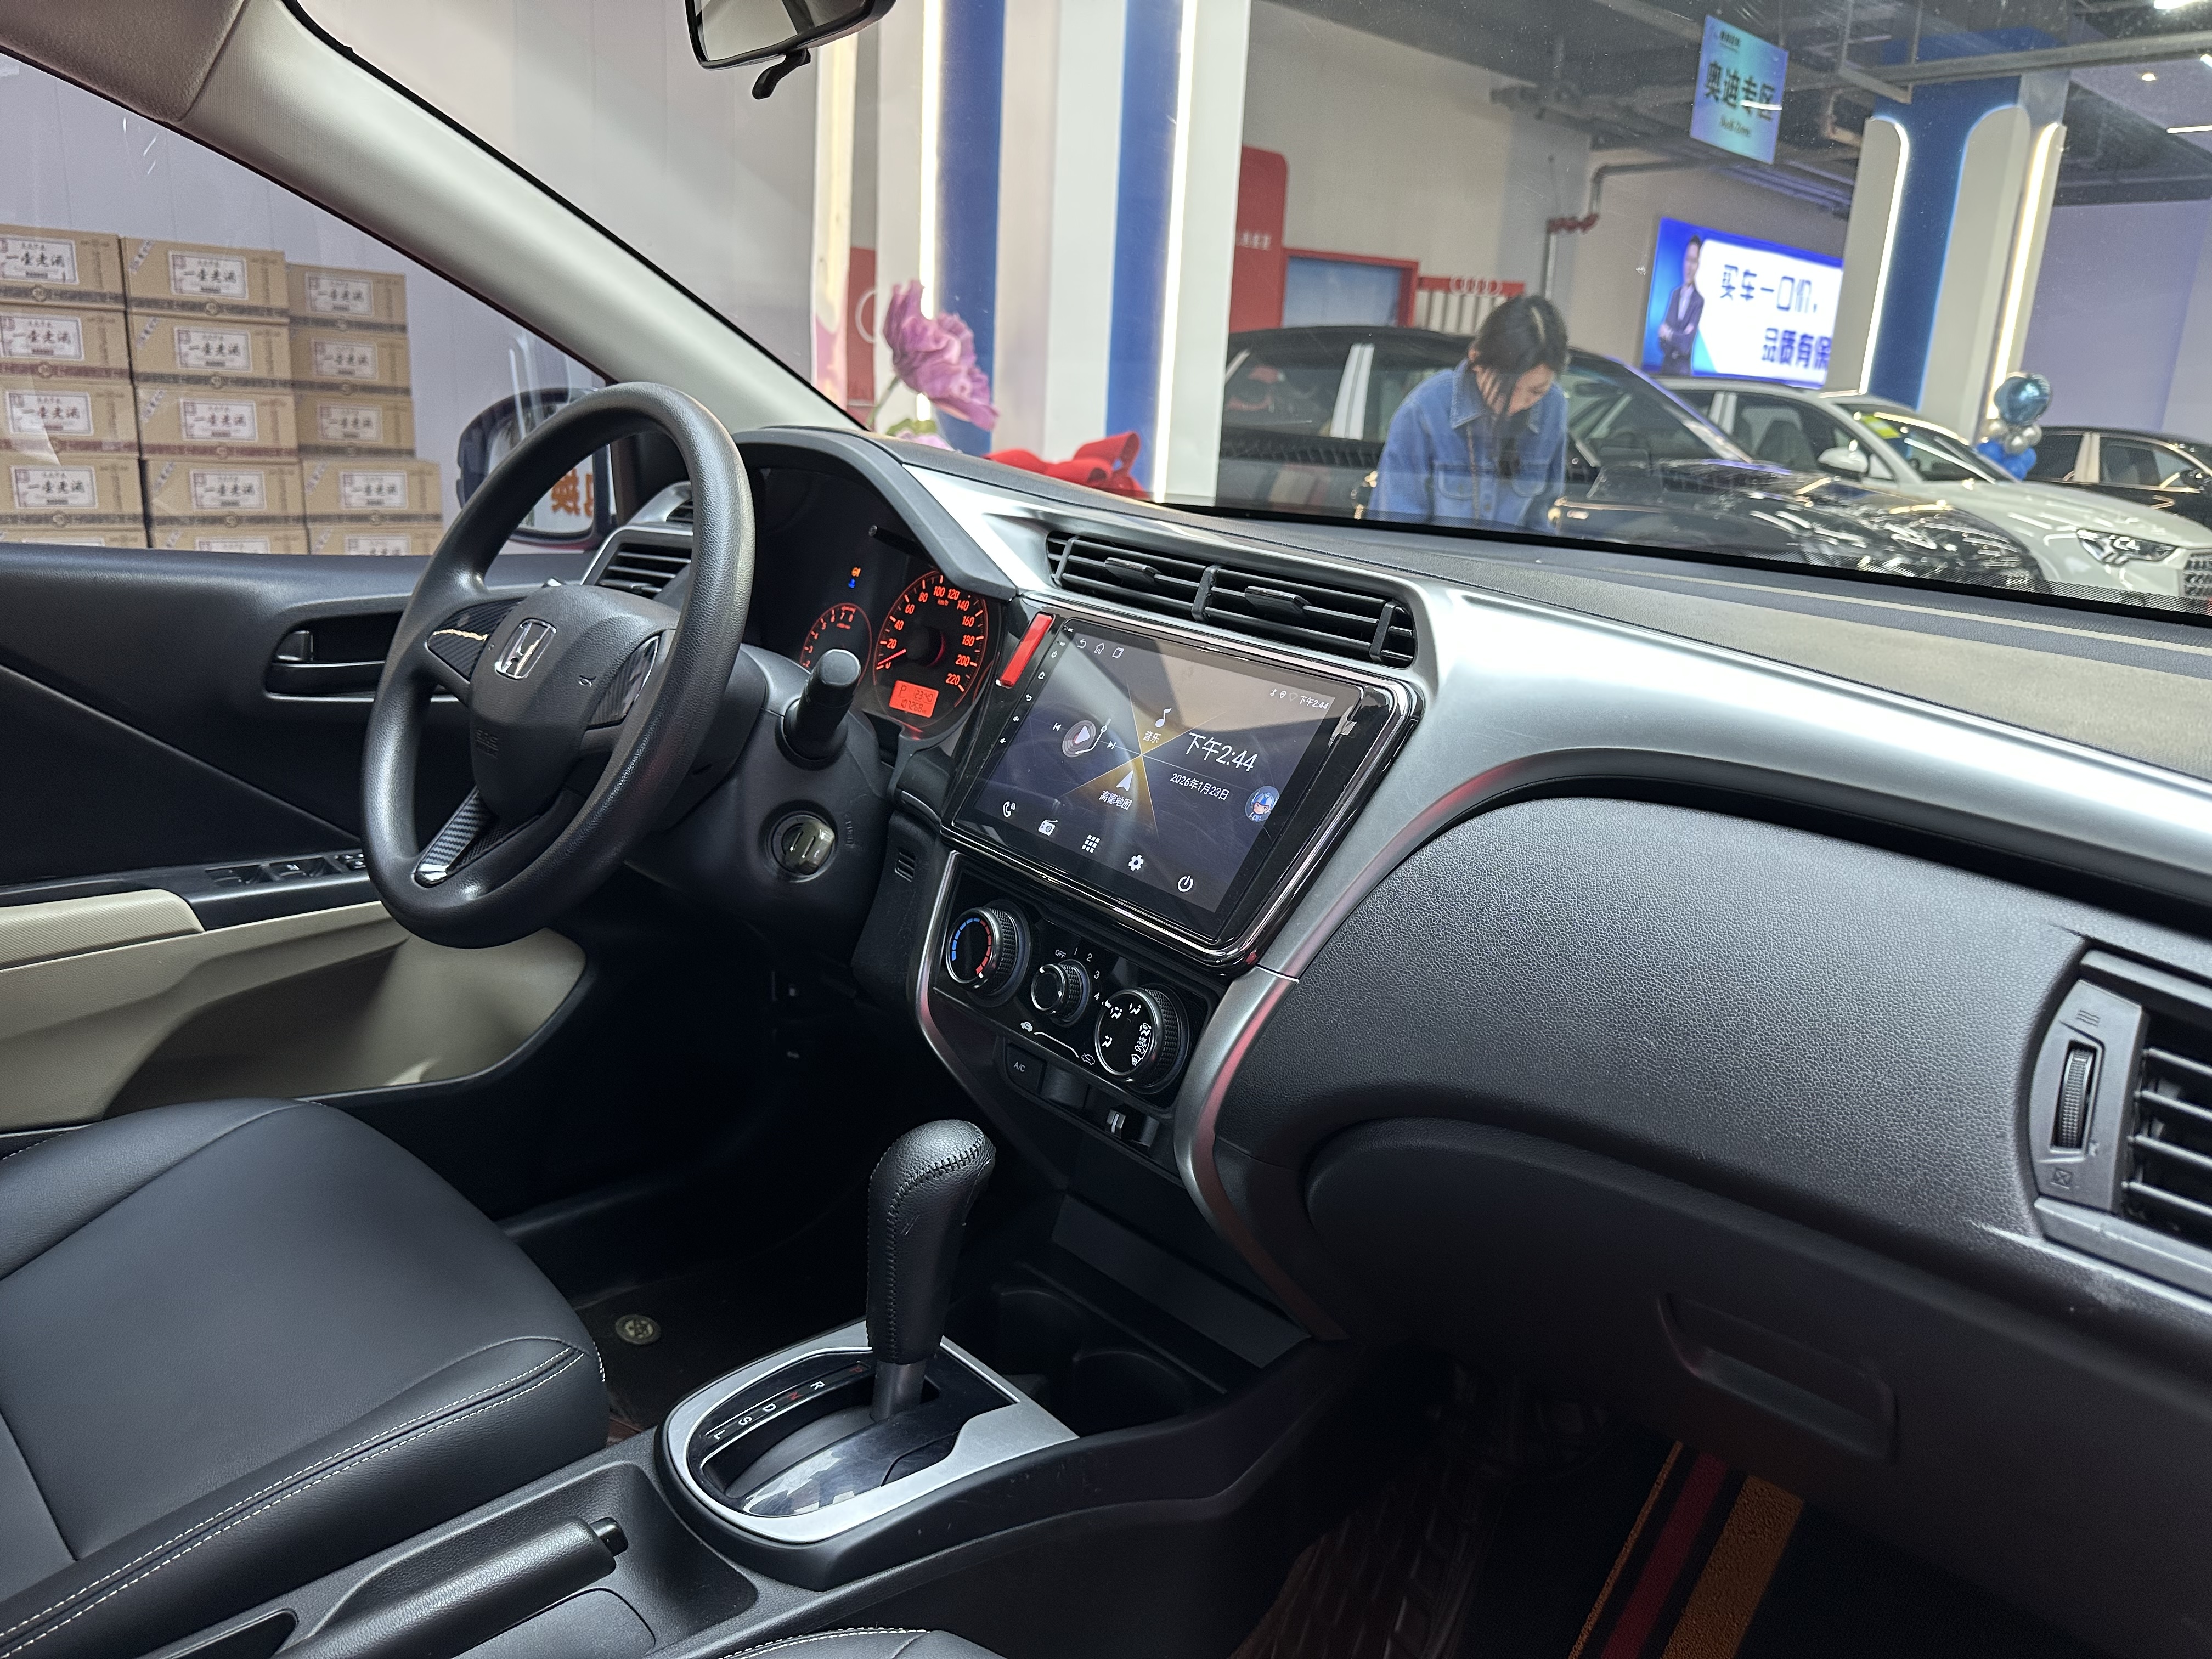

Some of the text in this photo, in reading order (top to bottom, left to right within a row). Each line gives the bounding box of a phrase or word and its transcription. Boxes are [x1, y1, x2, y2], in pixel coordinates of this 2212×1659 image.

[1705, 61, 1775, 121] 奥迪专区
[918, 592, 928, 602] 80
[933, 586, 946, 597] 100
[947, 589, 960, 600] 120
[905, 604, 915, 614] 60
[957, 600, 969, 611] 140
[894, 620, 904, 630] 40
[962, 616, 975, 627] 160
[887, 638, 897, 649] 20
[962, 635, 975, 646] 180
[956, 654, 970, 667] 200
[946, 673, 960, 685] 220
[1299, 695, 1329, 710] 下午2:44
[1143, 731, 1160, 743] 音乐
[1185, 732, 1259, 772] 下午2:44
[1170, 773, 1230, 801] 2026年1月23日
[1099, 791, 1133, 810] 高德地图
[1055, 949, 1066, 958] OFF
[1086, 953, 1093, 962] 2
[1094, 970, 1100, 979] 3
[1094, 992, 1100, 1001] 4
[1014, 1062, 1025, 1072] A/C
[810, 1381, 825, 1390] R
[762, 1403, 776, 1412] D
[738, 1416, 752, 1425] S
[714, 1429, 725, 1440] L
